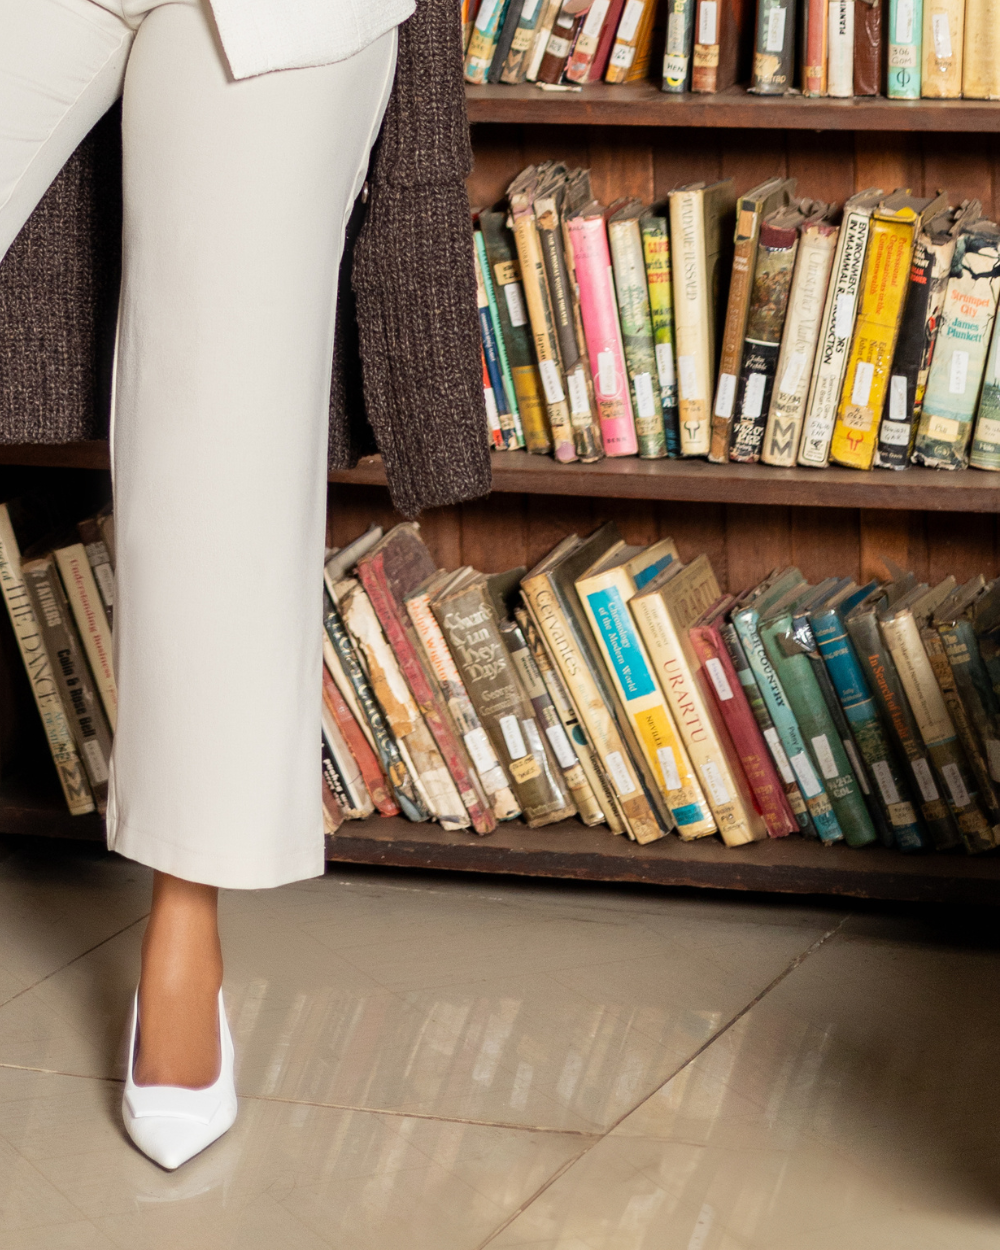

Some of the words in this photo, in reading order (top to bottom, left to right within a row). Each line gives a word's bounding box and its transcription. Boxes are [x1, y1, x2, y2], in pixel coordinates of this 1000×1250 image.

[891, 57, 912, 65] GOM
[892, 48, 910, 56] 306
[681, 197, 697, 249] MADAME
[849, 219, 858, 230] IN
[547, 234, 556, 247] THE
[549, 246, 561, 277] NATIONAL
[837, 231, 856, 286] MAMMAL
[869, 233, 889, 295] Commonwealth
[879, 234, 899, 293] Organizations
[891, 237, 908, 288] Professional
[553, 277, 563, 299] YOUTH
[683, 250, 698, 301] TUSSAUD
[801, 250, 825, 312] Christopher
[875, 302, 885, 315] the
[950, 289, 990, 307] Strumpet
[960, 304, 978, 318] City
[557, 299, 569, 327] THEATRE
[952, 317, 979, 331] James
[535, 332, 549, 361] Japan
[858, 337, 870, 356] John
[946, 326, 983, 343] Plunkett
[876, 341, 888, 365] Edited
[0, 568, 12, 582] of
[35, 580, 62, 628] FATHERS
[68, 559, 100, 623] Understanding
[91, 623, 110, 668] Business
[410, 598, 431, 635] Ralph
[597, 606, 607, 617] of
[533, 587, 582, 677] Cervantes
[601, 616, 613, 630] the
[607, 600, 631, 649] Chronology
[656, 620, 670, 645] ANCIENT
[6, 577, 36, 628] THE
[21, 631, 58, 710] DANCE
[607, 631, 626, 664] Modern
[57, 648, 72, 674] Colin
[463, 657, 508, 683] Days
[868, 653, 882, 667] In
[620, 665, 637, 692] World
[755, 647, 785, 709] COUNTRY
[873, 664, 896, 701] Search
[70, 684, 87, 716] Rose
[663, 656, 708, 745] URARTU
[887, 698, 901, 711] of
[78, 715, 96, 739] Bell
[646, 715, 662, 752] NEVILLE
[891, 710, 912, 739] Light
[588, 753, 611, 796] generation
